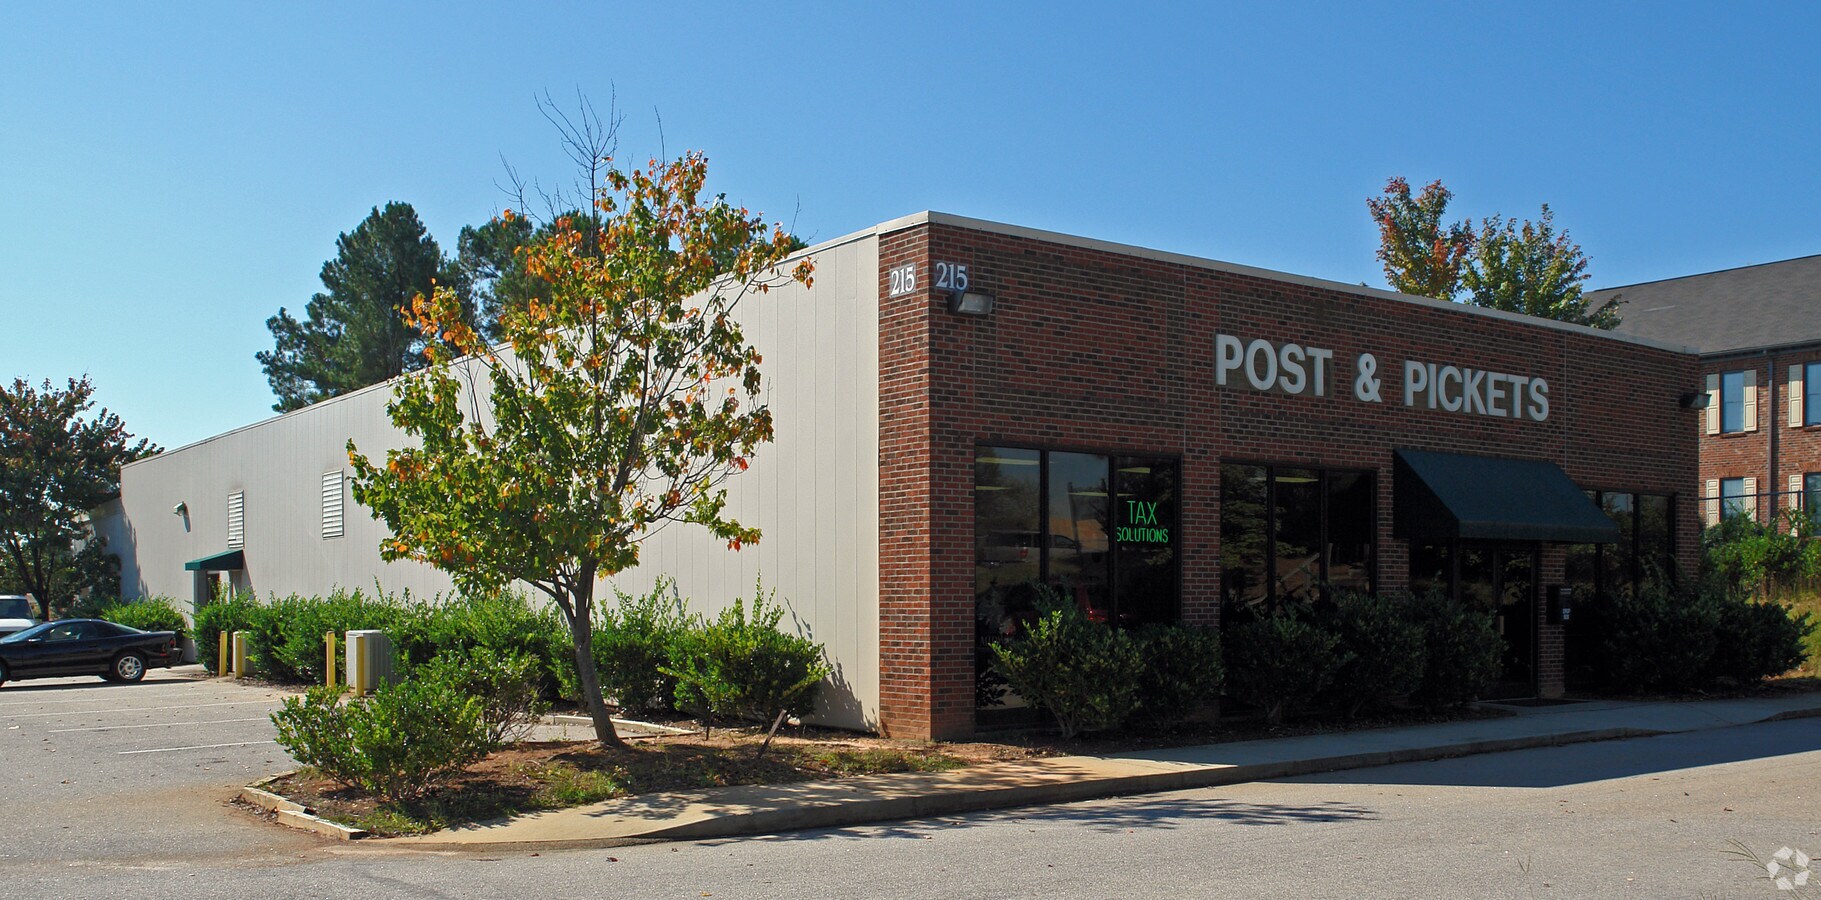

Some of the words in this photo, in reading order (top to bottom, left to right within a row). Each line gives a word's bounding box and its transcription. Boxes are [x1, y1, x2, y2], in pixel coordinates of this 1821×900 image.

[890, 266, 915, 297] 215
[936, 262, 968, 291] 215
[1215, 334, 1333, 397] POST
[1354, 353, 1383, 403] &
[1404, 360, 1550, 422] PICKETS
[1127, 500, 1157, 525] TAX
[1117, 527, 1169, 543] SOLUTIONS
